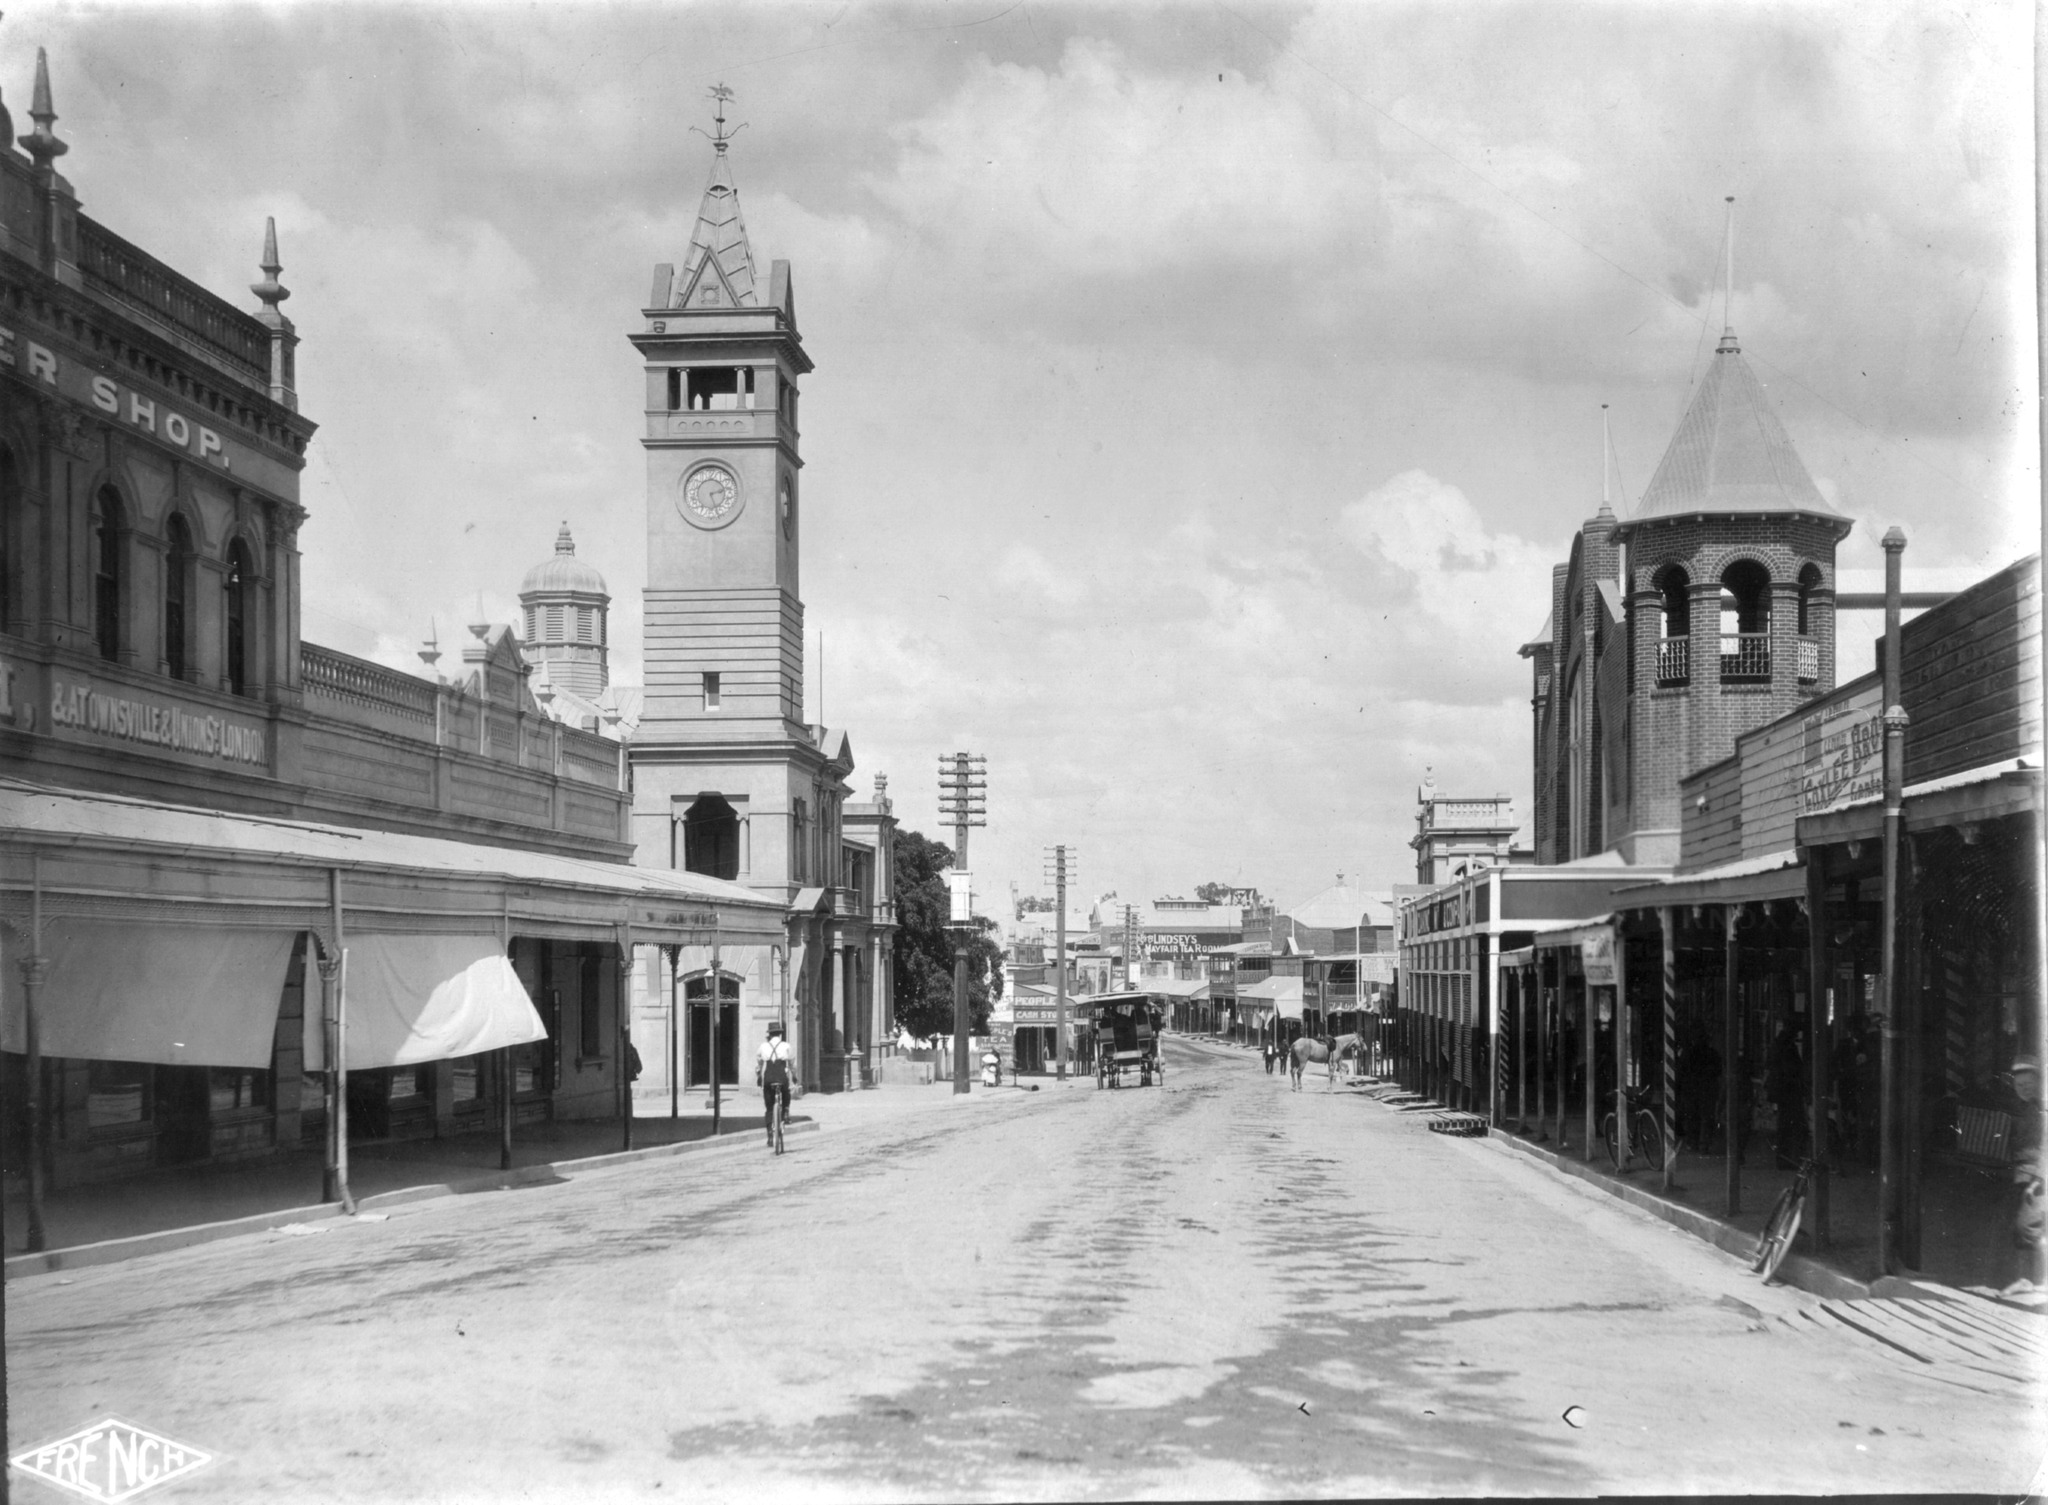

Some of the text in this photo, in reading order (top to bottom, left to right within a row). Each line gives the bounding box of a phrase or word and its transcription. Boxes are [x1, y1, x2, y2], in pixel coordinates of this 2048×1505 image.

[1153, 934, 1196, 945] LINDSEY'S
[1145, 943, 1178, 953] MAYFAIR
[1179, 944, 1194, 953] TEA
[1016, 1010, 1071, 1019] CASH STOE
